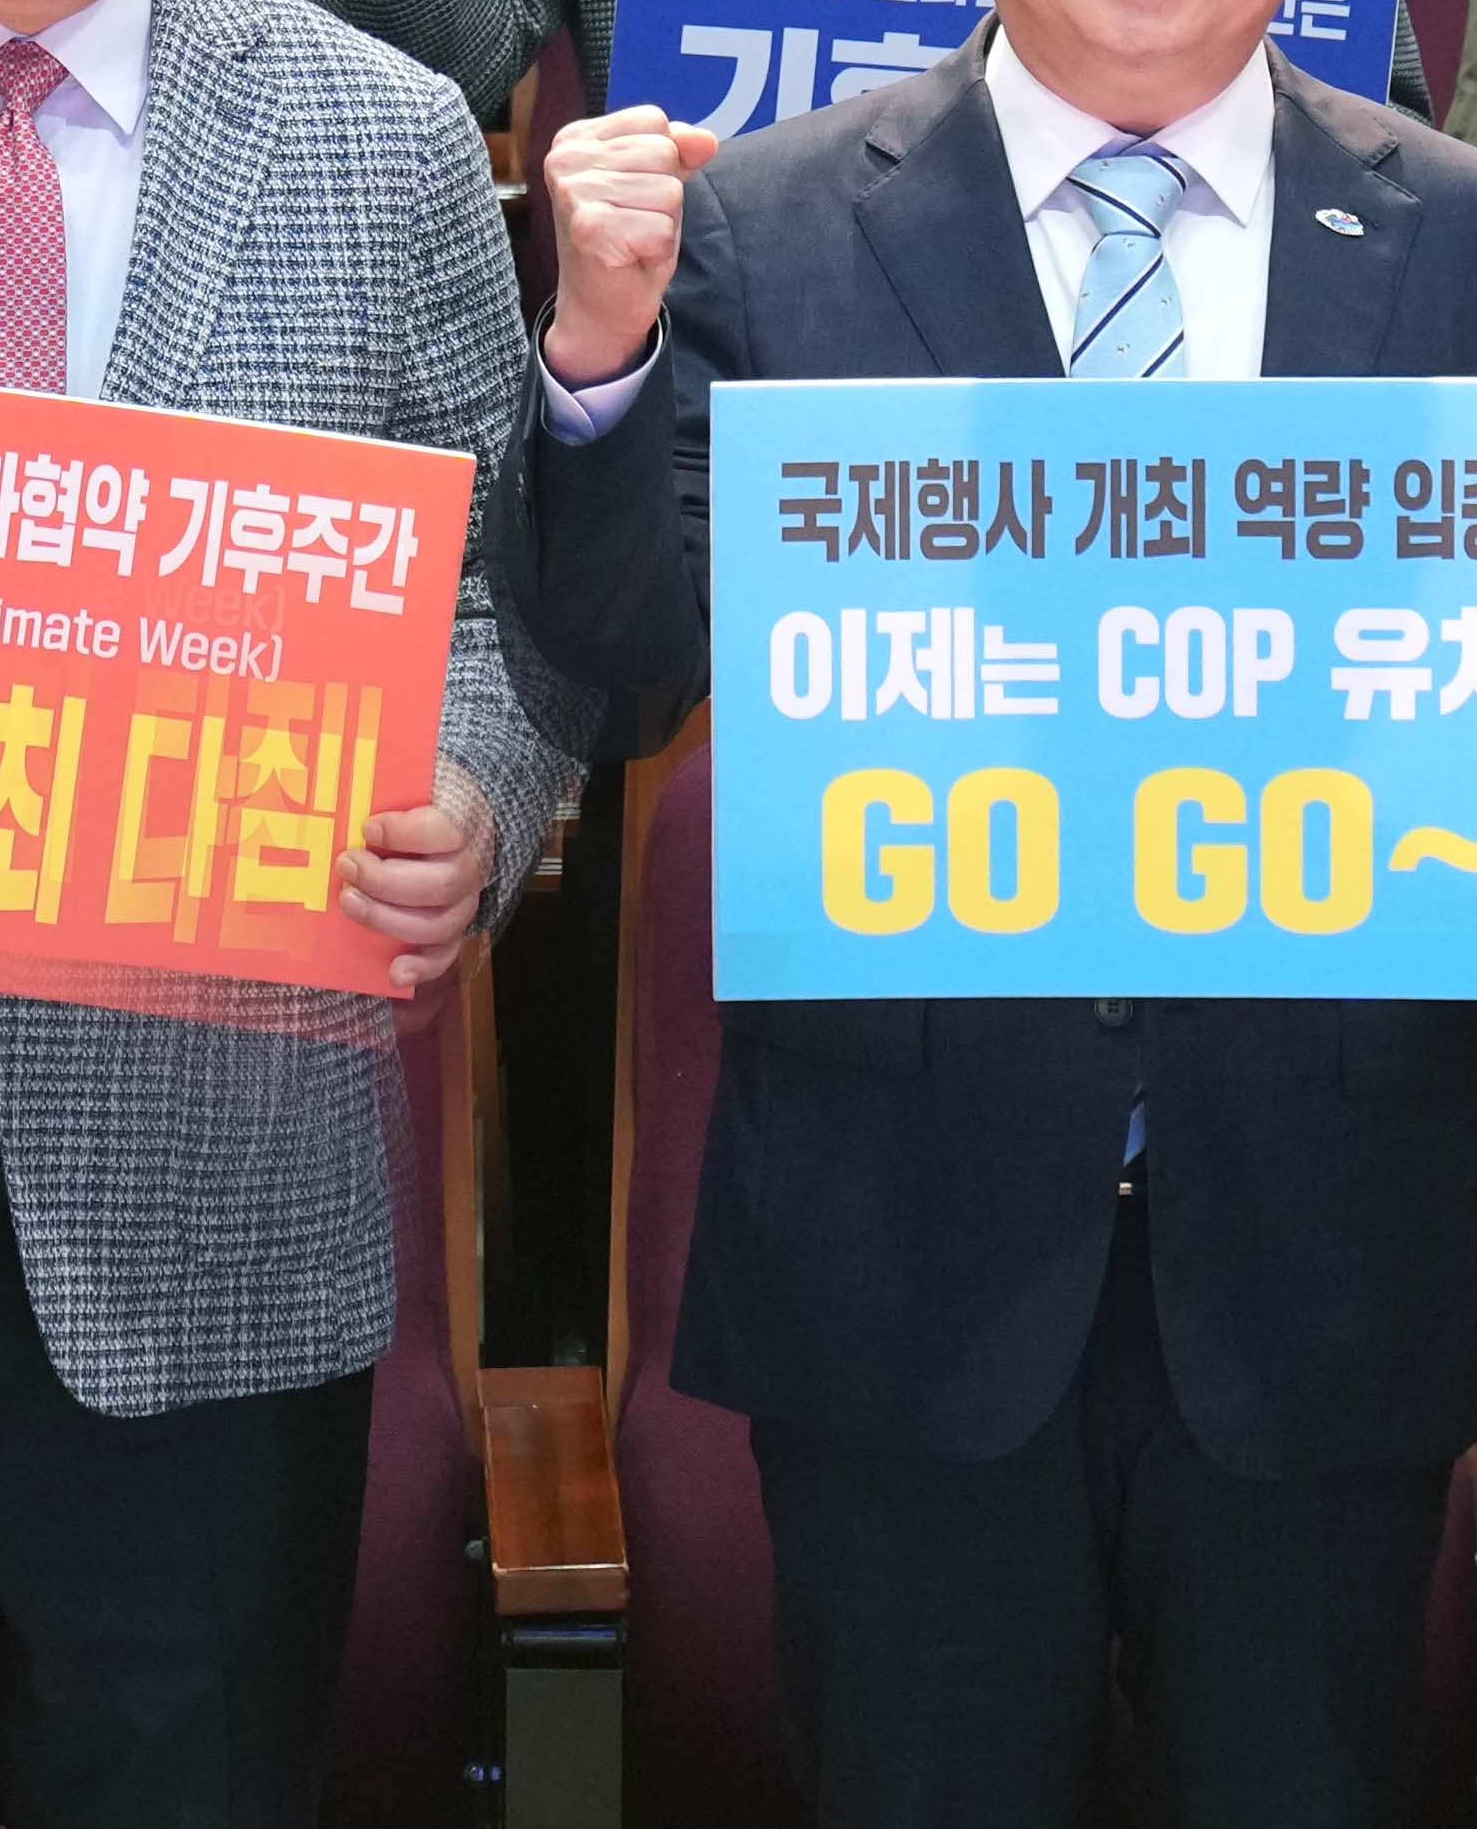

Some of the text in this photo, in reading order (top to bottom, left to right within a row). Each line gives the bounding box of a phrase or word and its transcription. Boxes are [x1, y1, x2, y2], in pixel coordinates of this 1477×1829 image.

[157, 478, 420, 618] 기후주간
[777, 458, 1053, 564] 국제행사
[1073, 458, 1208, 561] 개최
[1234, 458, 1372, 562] 역량
[139, 618, 285, 683] Week)
[769, 605, 1061, 722] 이제는
[1097, 604, 1295, 721] COP
[820, 765, 1061, 937] GO
